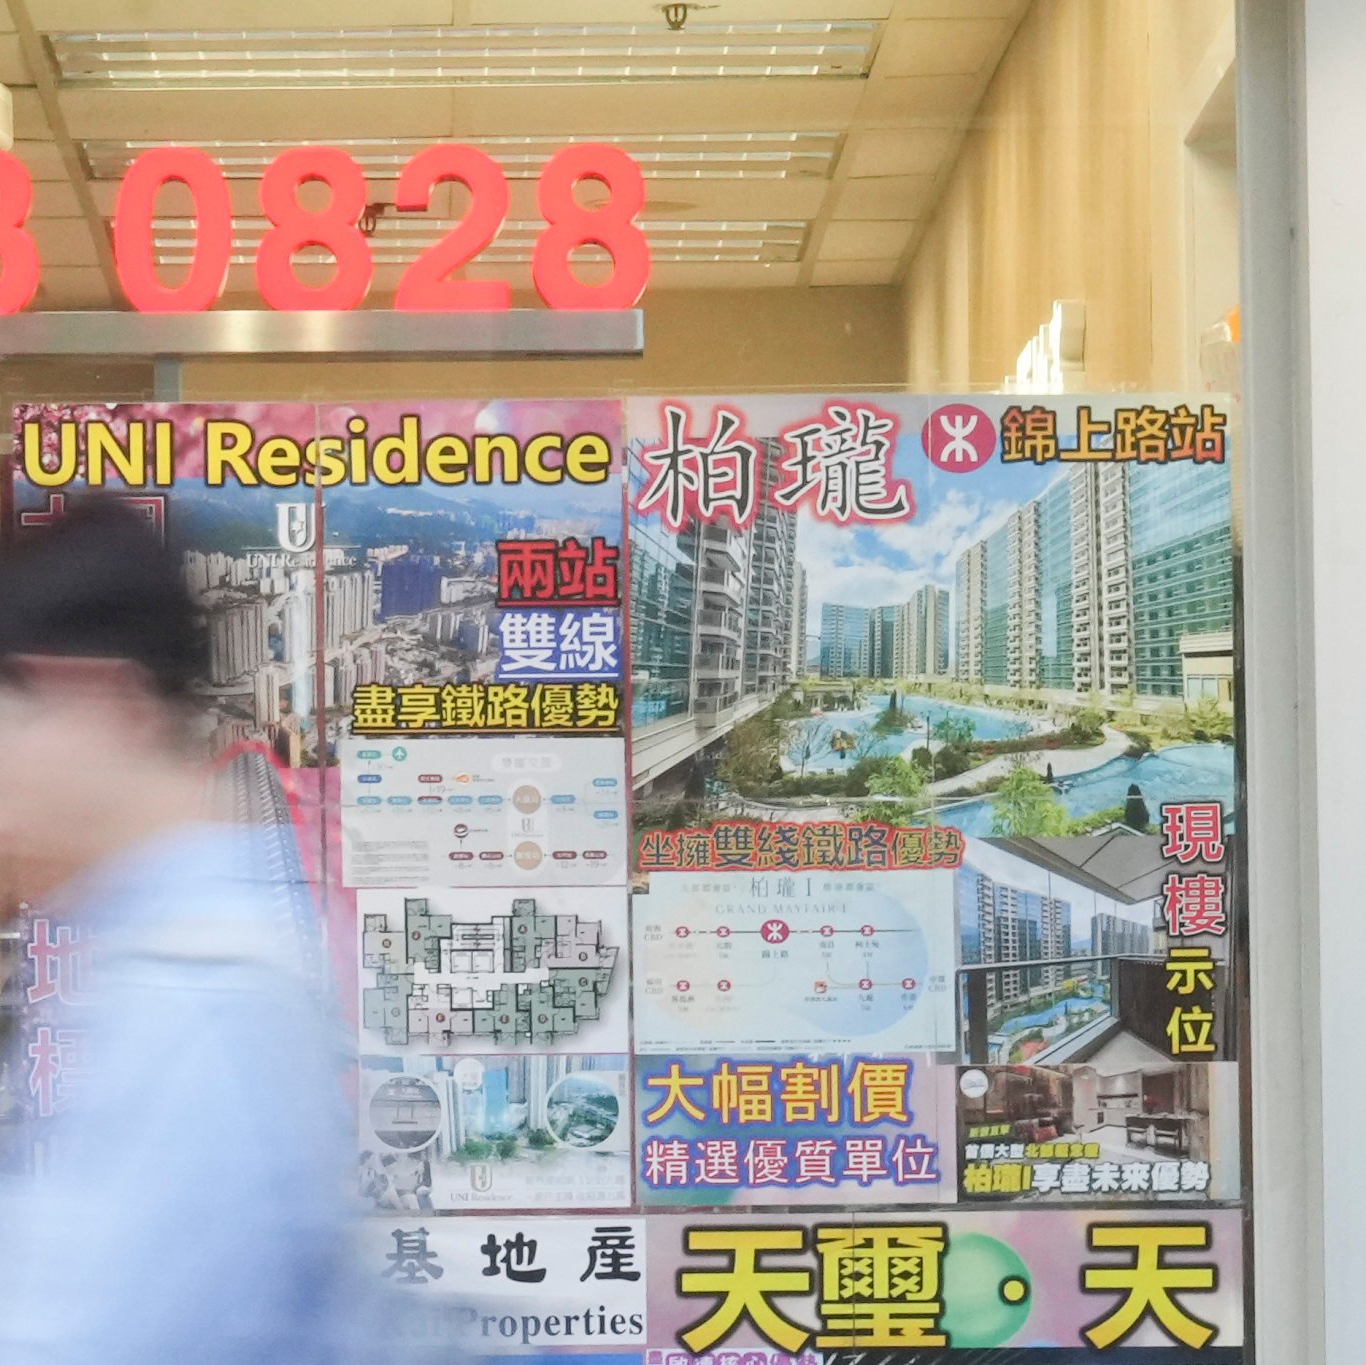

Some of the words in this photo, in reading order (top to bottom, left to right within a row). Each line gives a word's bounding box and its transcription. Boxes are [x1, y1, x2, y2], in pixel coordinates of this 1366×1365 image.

[114, 143, 652, 315] 0828
[23, 421, 172, 486] UNI
[206, 415, 611, 486] Residence
[1001, 405, 1228, 464] 錦上路站
[638, 406, 910, 526] 柏瓏
[498, 538, 619, 600] 兩站
[500, 614, 618, 672] 雙線
[353, 685, 618, 729] 盡享鐵路優勢
[647, 1061, 911, 1126] 大幅割價
[645, 1138, 936, 1185] 精選優質單位
